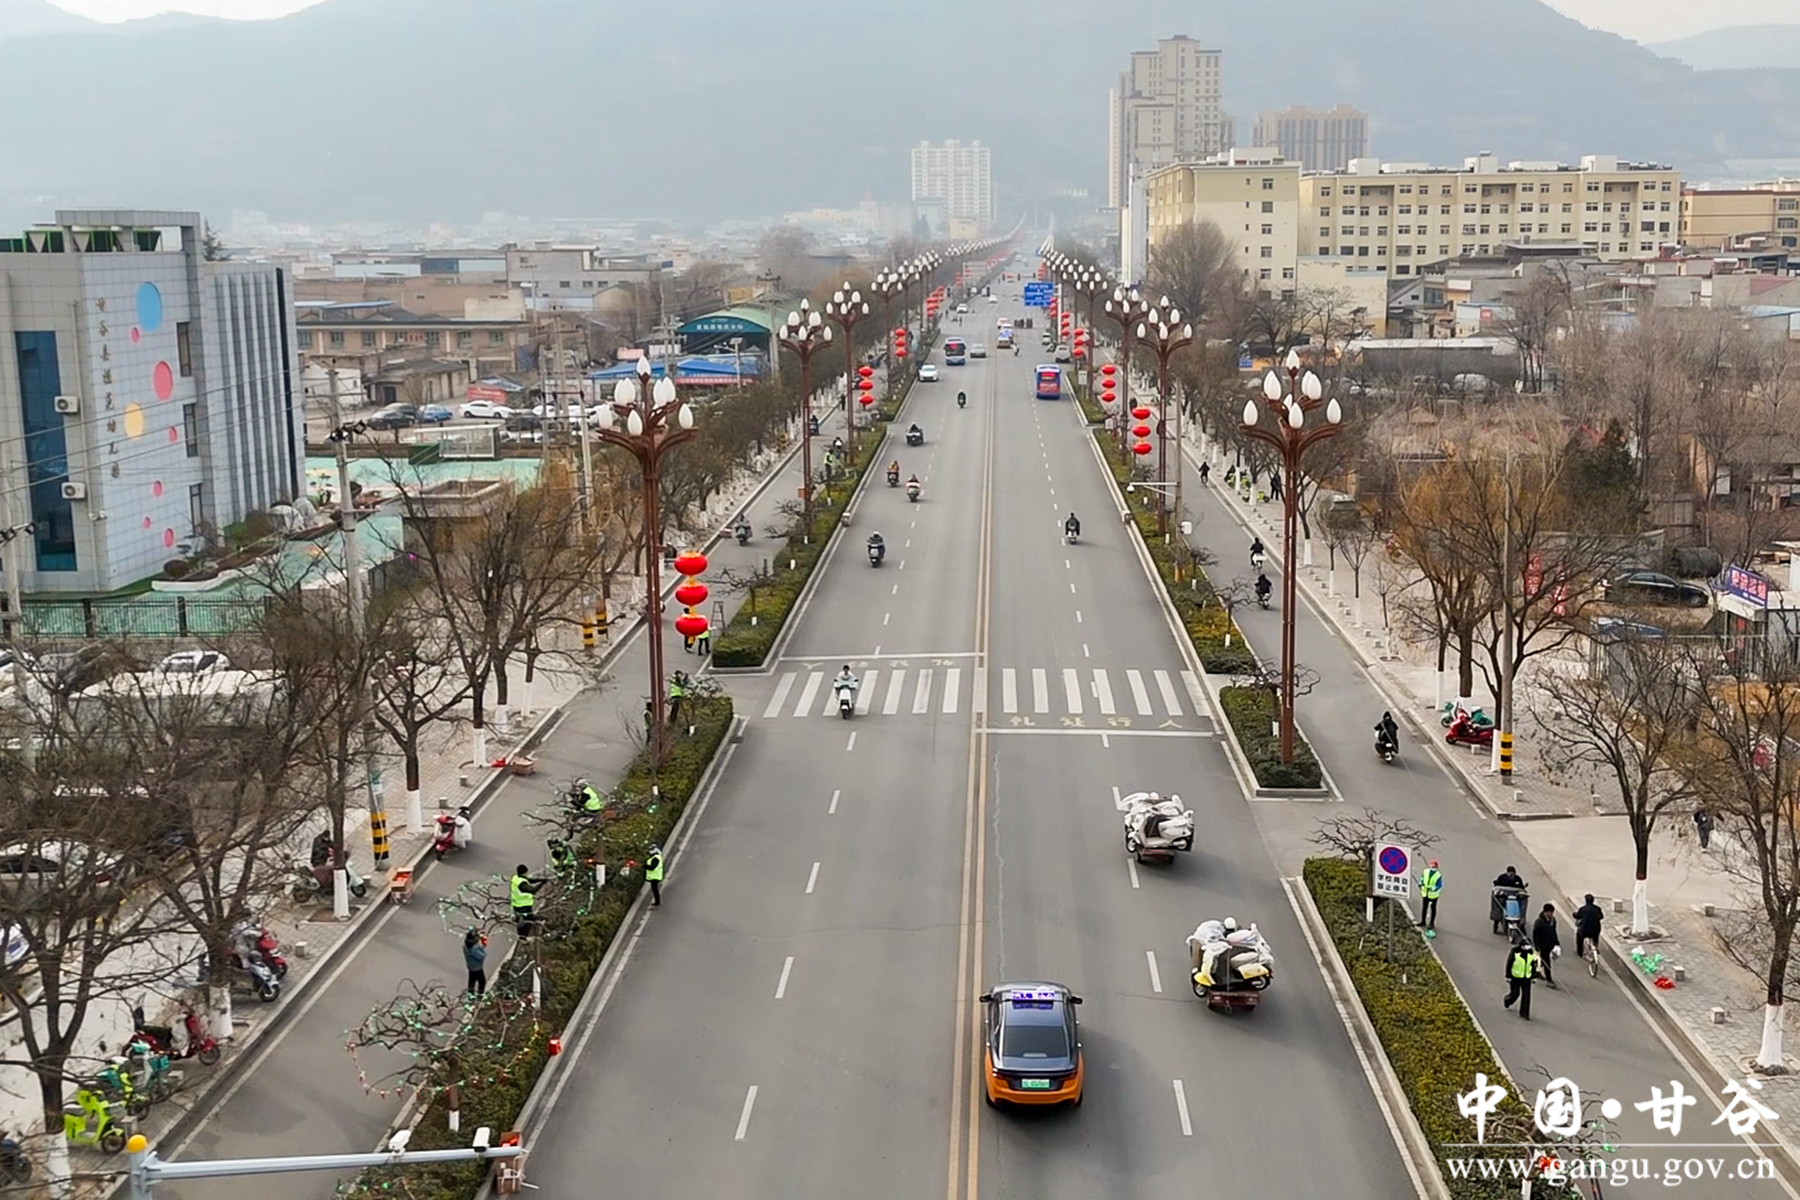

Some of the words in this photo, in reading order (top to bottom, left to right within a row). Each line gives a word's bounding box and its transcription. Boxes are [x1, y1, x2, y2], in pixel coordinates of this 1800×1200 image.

[1009, 716, 1183, 728] 礼让行人
[1377, 874, 1408, 885] 学校周边
[1377, 882, 1408, 893] 禁止停车
